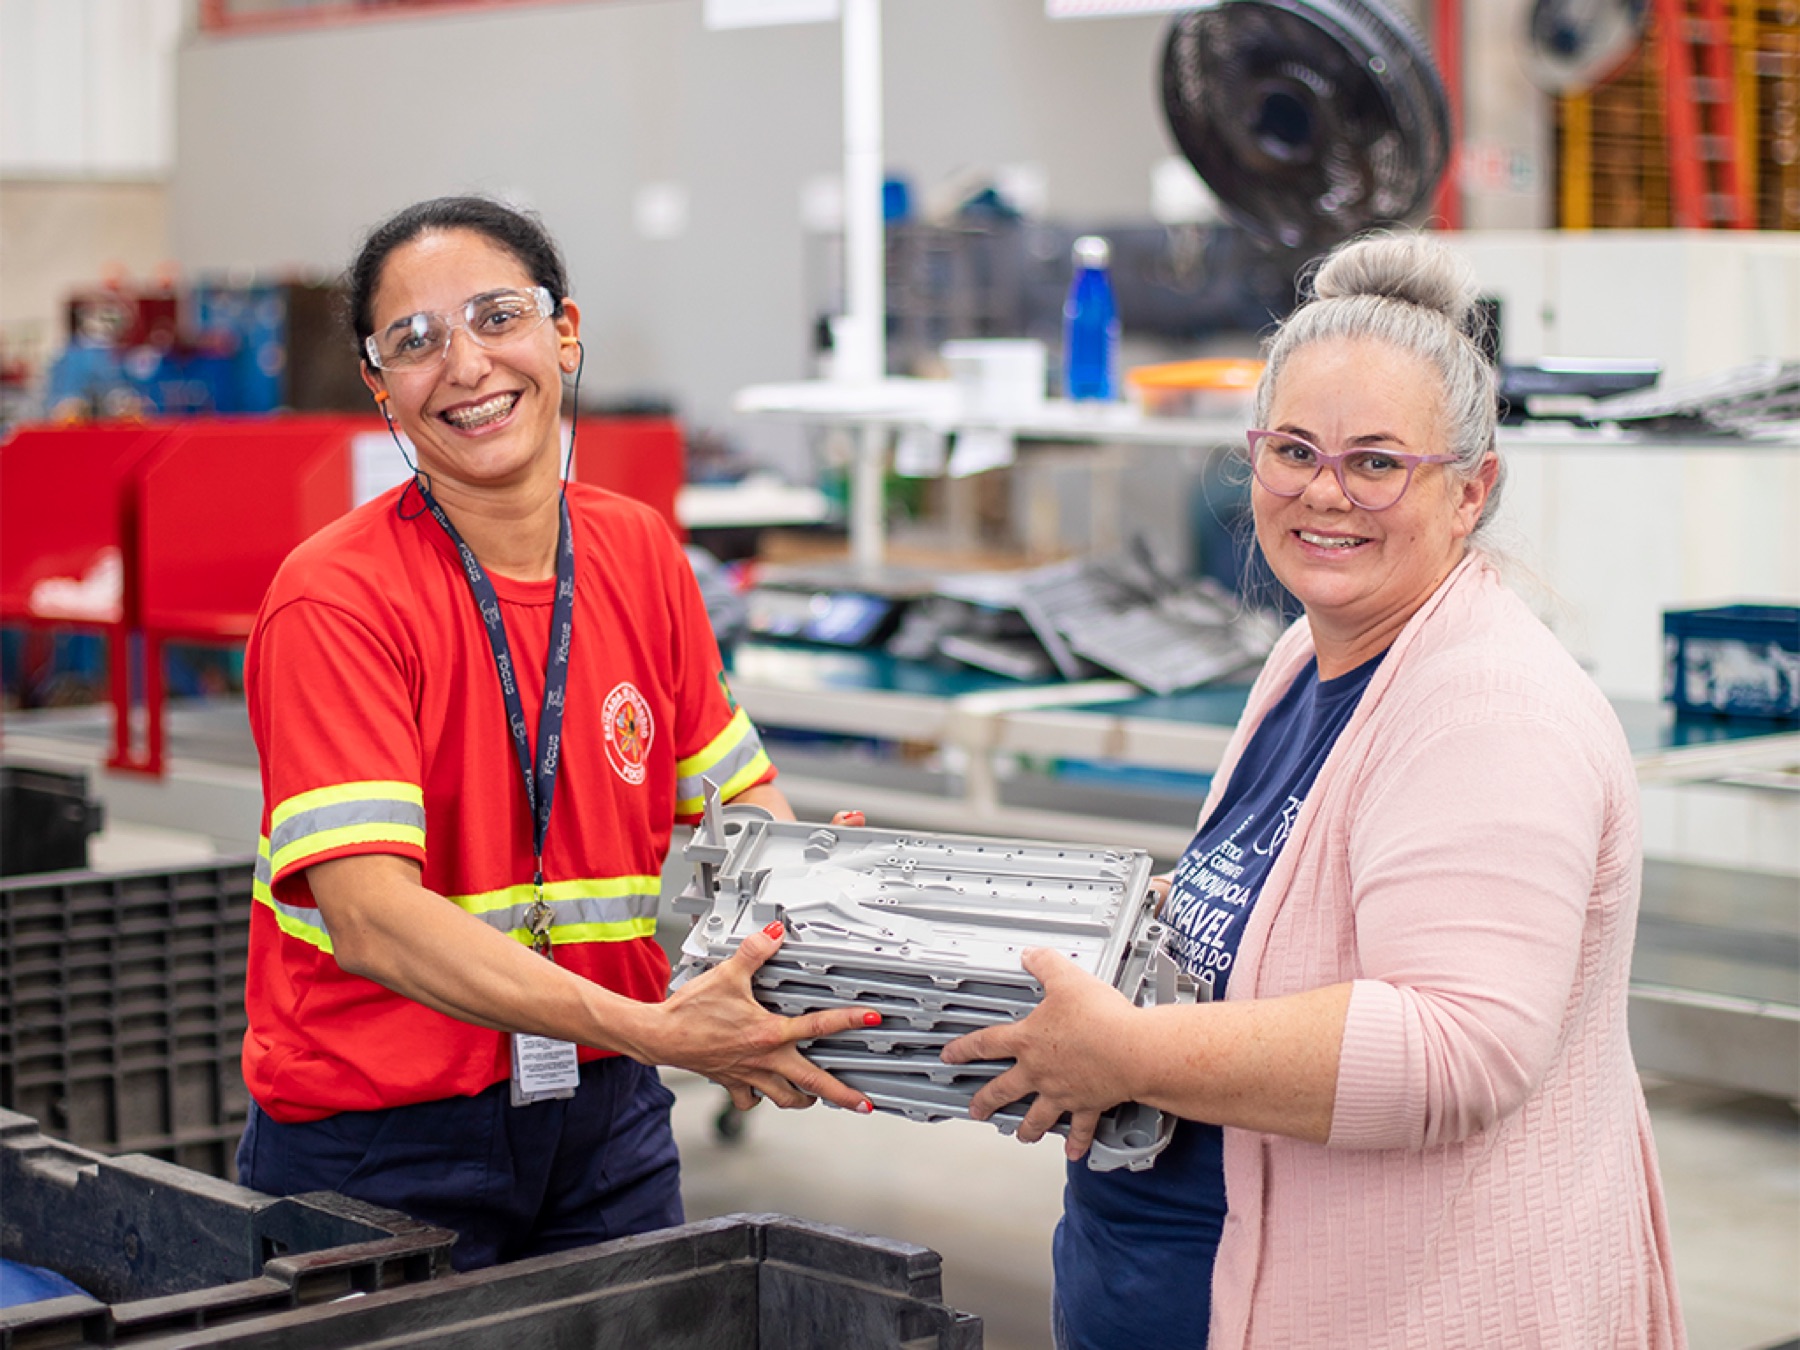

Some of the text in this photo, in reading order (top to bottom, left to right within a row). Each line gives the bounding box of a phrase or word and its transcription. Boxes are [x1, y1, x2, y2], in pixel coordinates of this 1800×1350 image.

[459, 542, 482, 583] FOCUS
[559, 621, 572, 664] FOCUS
[498, 653, 516, 695] FOCUS
[544, 734, 560, 775] FOCUS
[1206, 948, 1232, 971] DO
